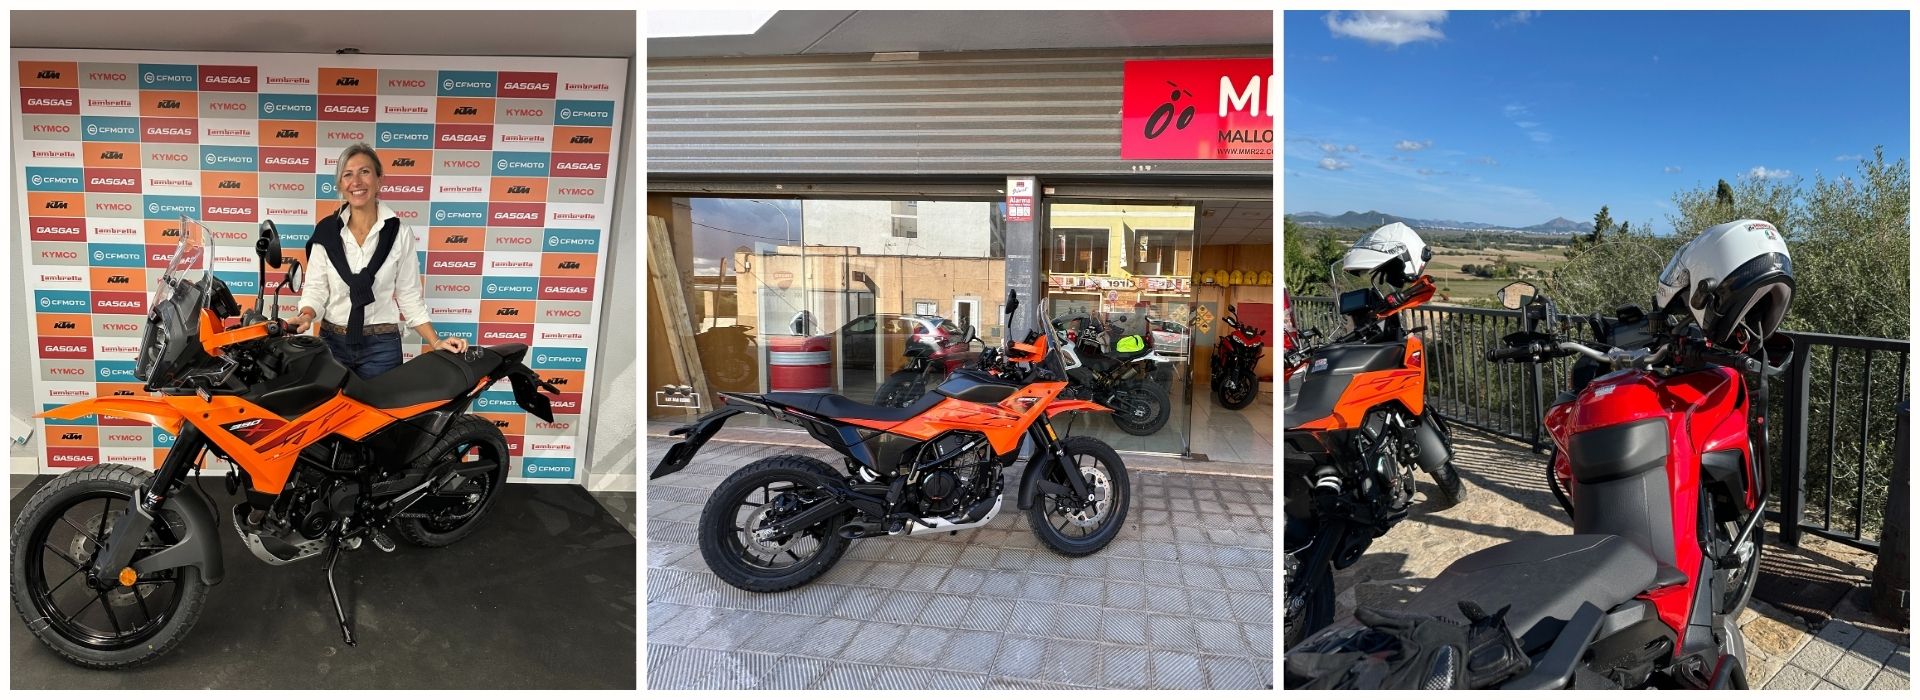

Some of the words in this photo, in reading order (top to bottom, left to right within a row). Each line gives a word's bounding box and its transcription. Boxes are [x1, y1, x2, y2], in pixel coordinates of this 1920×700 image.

[37, 70, 60, 80] KTM
[89, 72, 126, 81] KYMCO
[205, 75, 251, 84] GASGAS
[336, 77, 359, 87] KTM
[504, 82, 550, 90] GASGAS
[1219, 75, 1273, 117] M
[28, 98, 72, 106] GASGAS
[158, 100, 180, 109] KTM
[210, 102, 246, 110] KYMCO
[454, 107, 477, 116] KTM
[506, 109, 543, 117] KYMCO
[33, 125, 70, 133] KYMCO
[276, 130, 298, 139] KTM
[442, 134, 486, 142] GASGAS
[1218, 130, 1273, 142] MALLO
[570, 136, 593, 144] KTM
[101, 152, 123, 160] KTM
[392, 158, 416, 167] KTM
[91, 178, 135, 186] GASGAS
[218, 181, 240, 189] KTM
[269, 183, 304, 191] KYMCO
[508, 185, 530, 194] KTM
[558, 188, 594, 196] KYMCO
[46, 201, 68, 209] KTM
[96, 203, 132, 211] KYMCO
[445, 235, 468, 243] KTM
[558, 262, 580, 270] KTM
[107, 276, 129, 284] KTM
[545, 286, 588, 294] GASGAS
